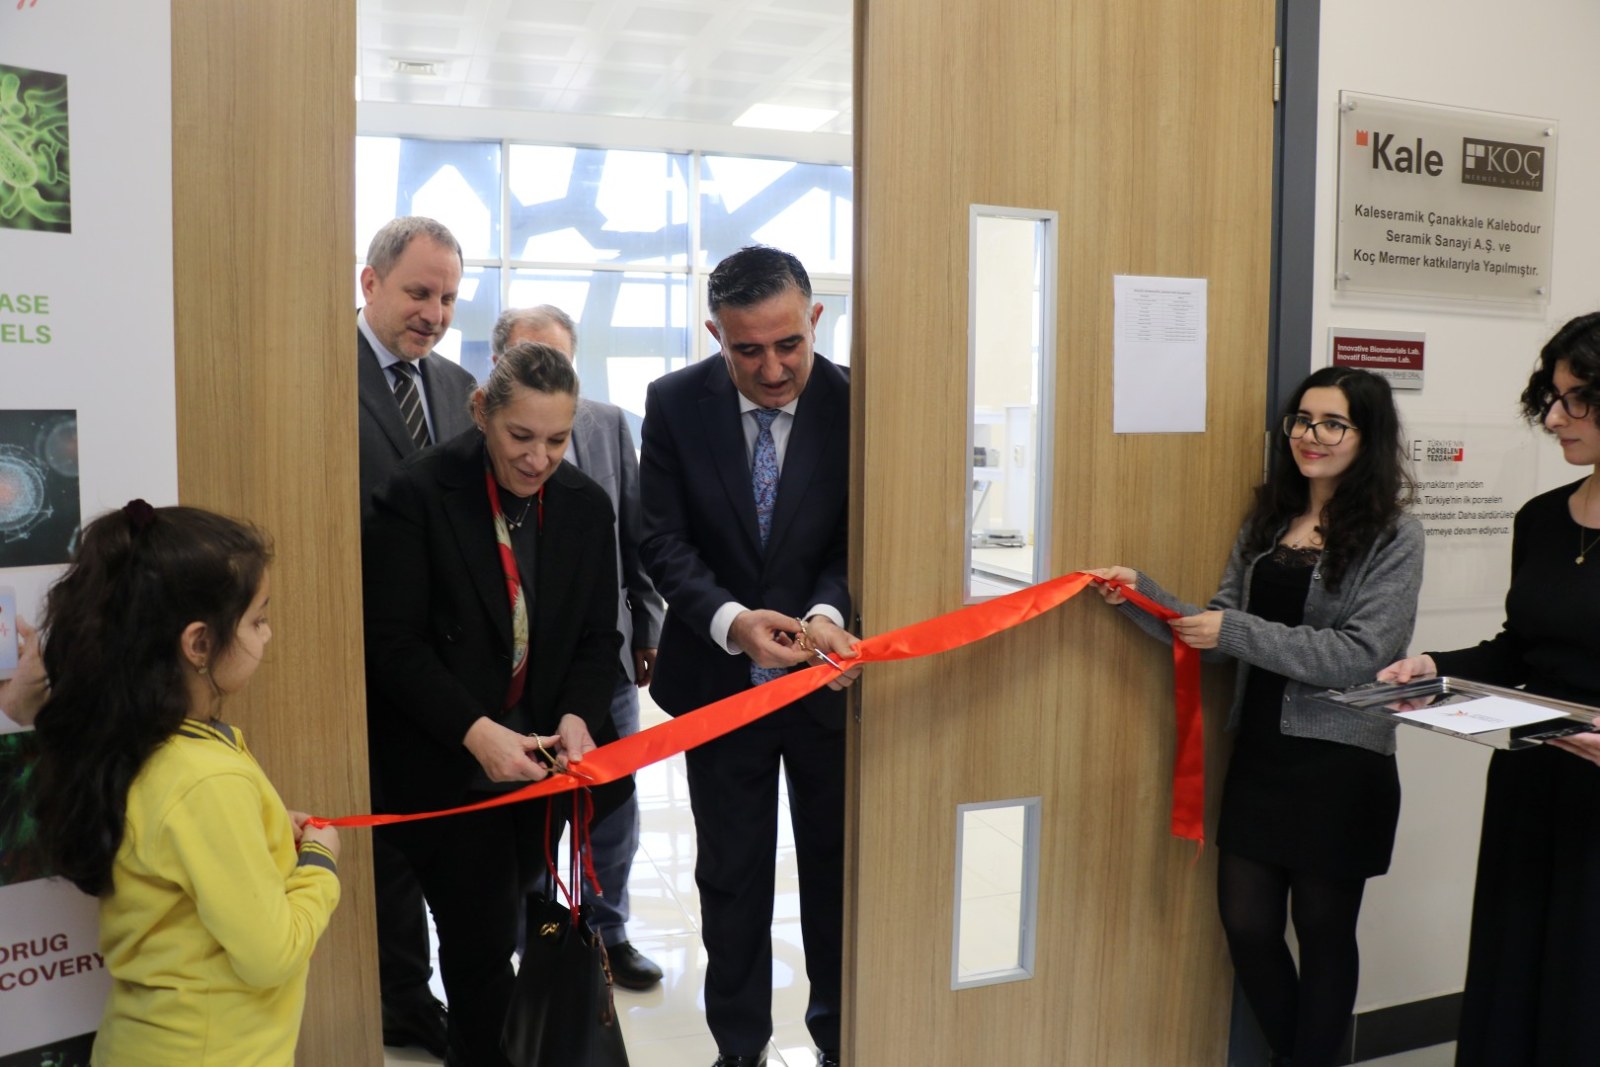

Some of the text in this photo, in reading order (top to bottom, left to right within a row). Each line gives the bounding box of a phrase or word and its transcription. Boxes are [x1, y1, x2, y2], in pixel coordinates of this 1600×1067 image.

[1372, 131, 1444, 177] Kale
[1486, 145, 1541, 179] KOÇ
[1354, 204, 1541, 234] Kaleseramik Çanakkale Kalebodur
[1386, 230, 1512, 253] Seramik Sanayi A.Ş. ve
[1353, 249, 1539, 277] Koç Mermer katkılarıyla Yapılmıştır.
[1337, 344, 1369, 353] Innovative
[1370, 346, 1407, 355] Biomaterials
[1456, 481, 1484, 490] yeniden
[1473, 496, 1503, 505] porselen
[1458, 511, 1477, 519] Daha
[1454, 527, 1478, 536] devam
